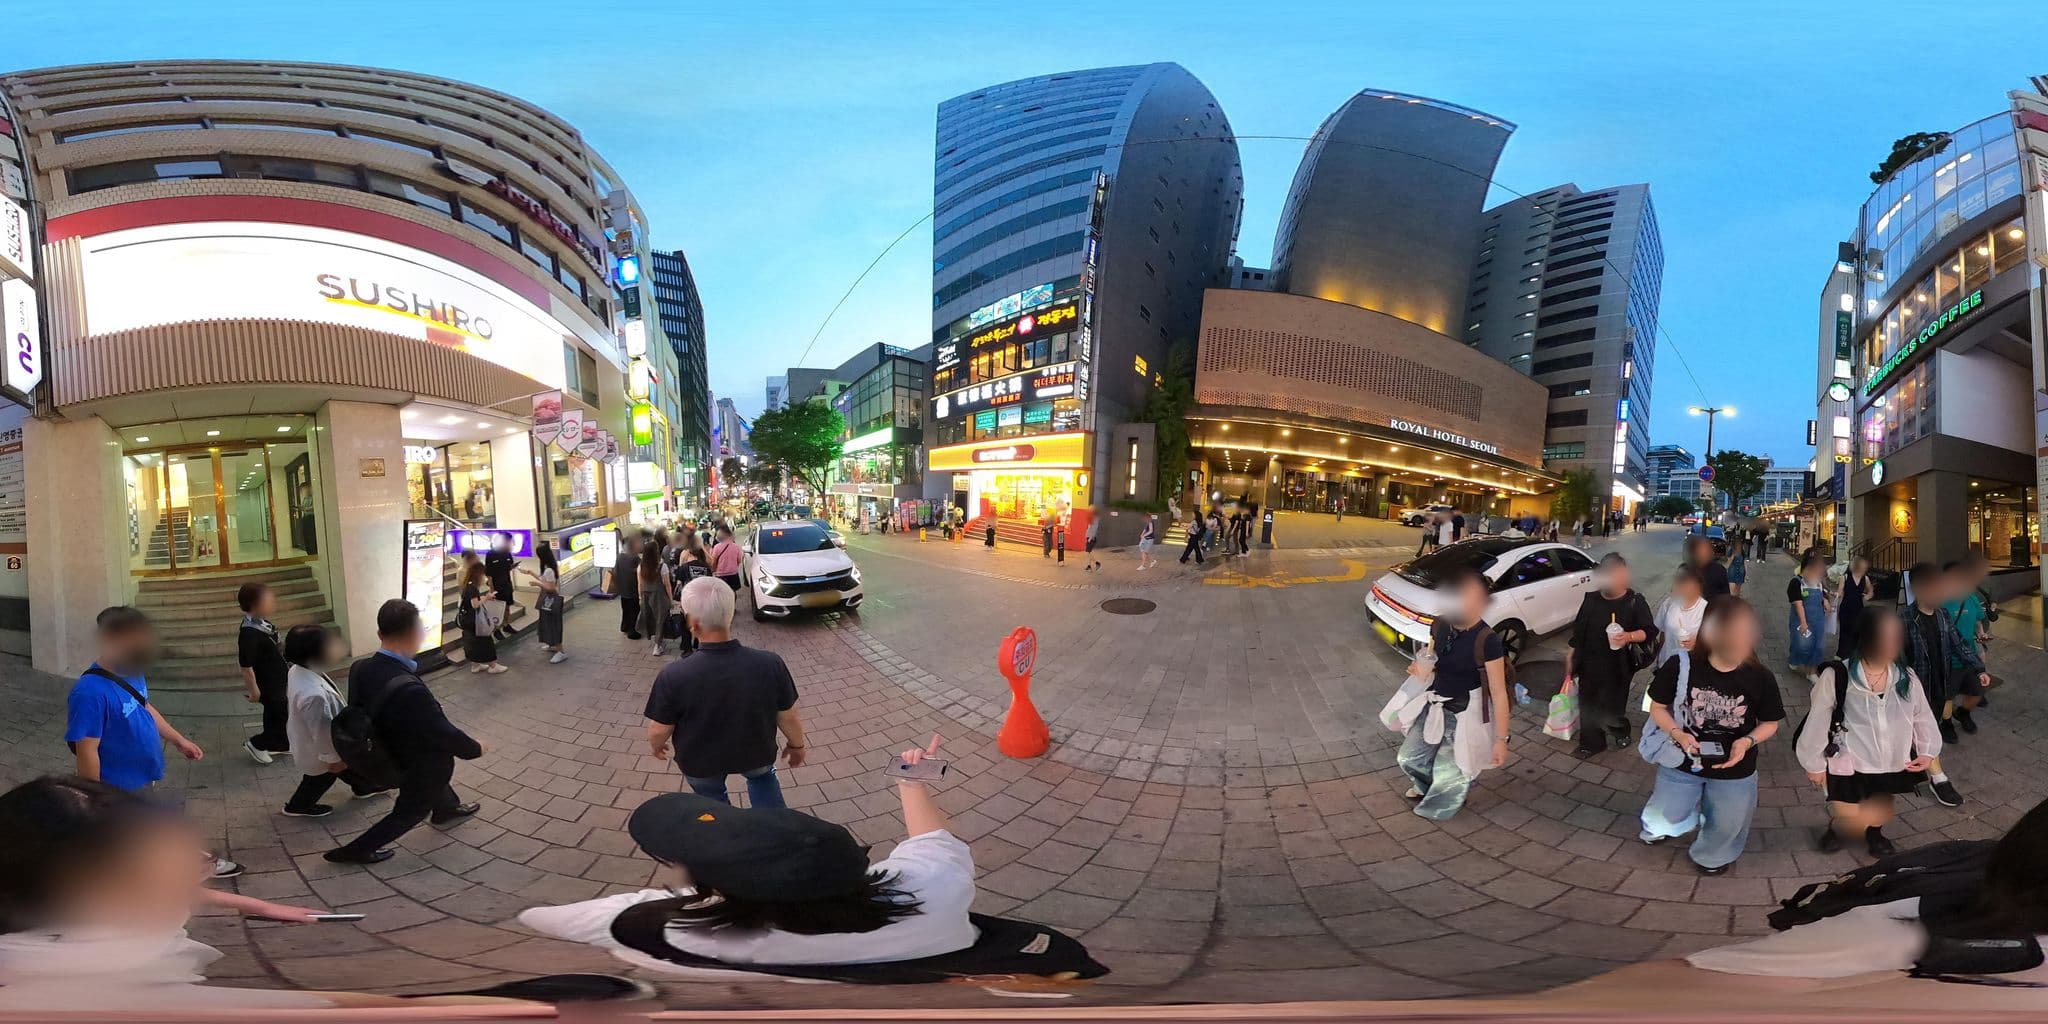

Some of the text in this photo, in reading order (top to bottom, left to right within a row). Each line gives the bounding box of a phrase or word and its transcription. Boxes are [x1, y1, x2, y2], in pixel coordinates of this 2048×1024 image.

[317, 274, 492, 340] SUSHIRO
[17, 332, 33, 374] CU
[1863, 338, 1917, 397] STARBUCKS
[1919, 289, 1982, 344] COFFEE
[1391, 420, 1498, 454] ROYAL HOTEL SEOUL
